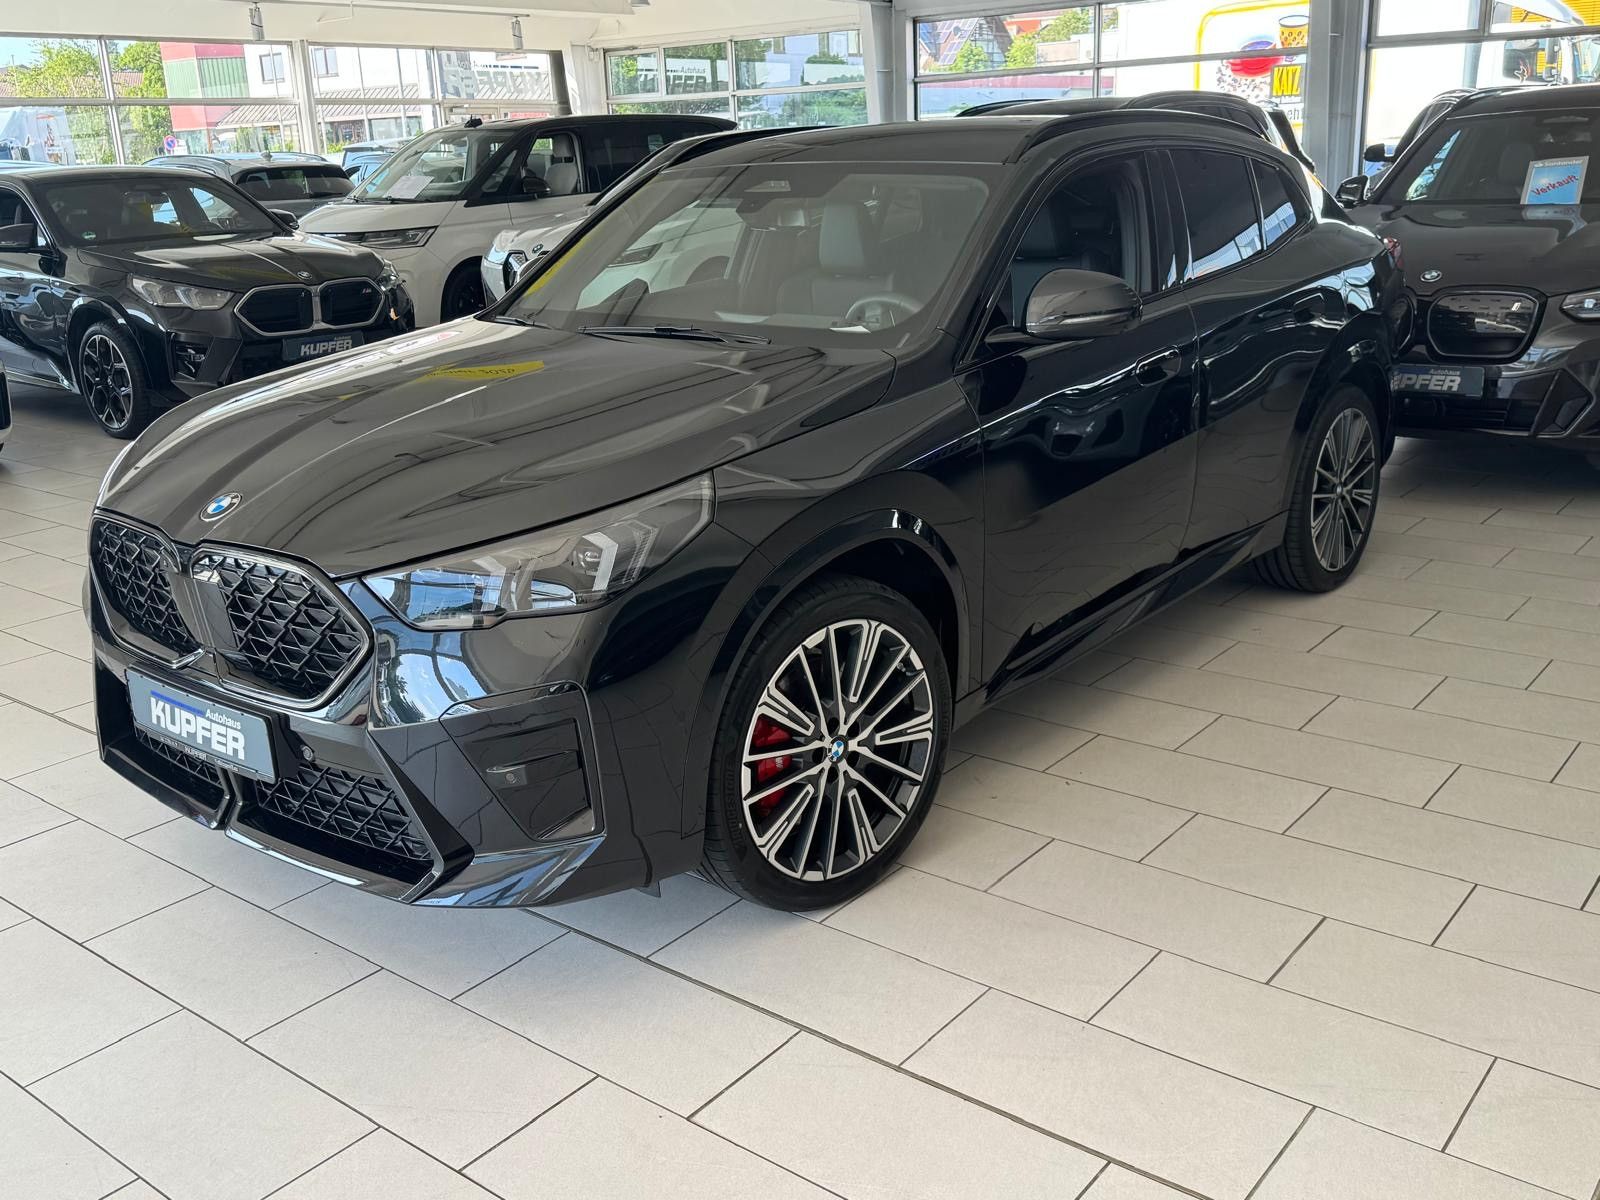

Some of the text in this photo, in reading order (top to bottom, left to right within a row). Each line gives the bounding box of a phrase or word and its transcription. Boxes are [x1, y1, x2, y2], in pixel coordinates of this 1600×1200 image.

[1272, 65, 1302, 96] KATZ
[1531, 174, 1580, 196] Verkauft
[300, 339, 352, 356] KUPFER
[1391, 373, 1461, 392] PFER
[1429, 368, 1461, 376] Autohaus
[151, 697, 245, 760] KUPFER
[205, 709, 241, 730] Autohaus
